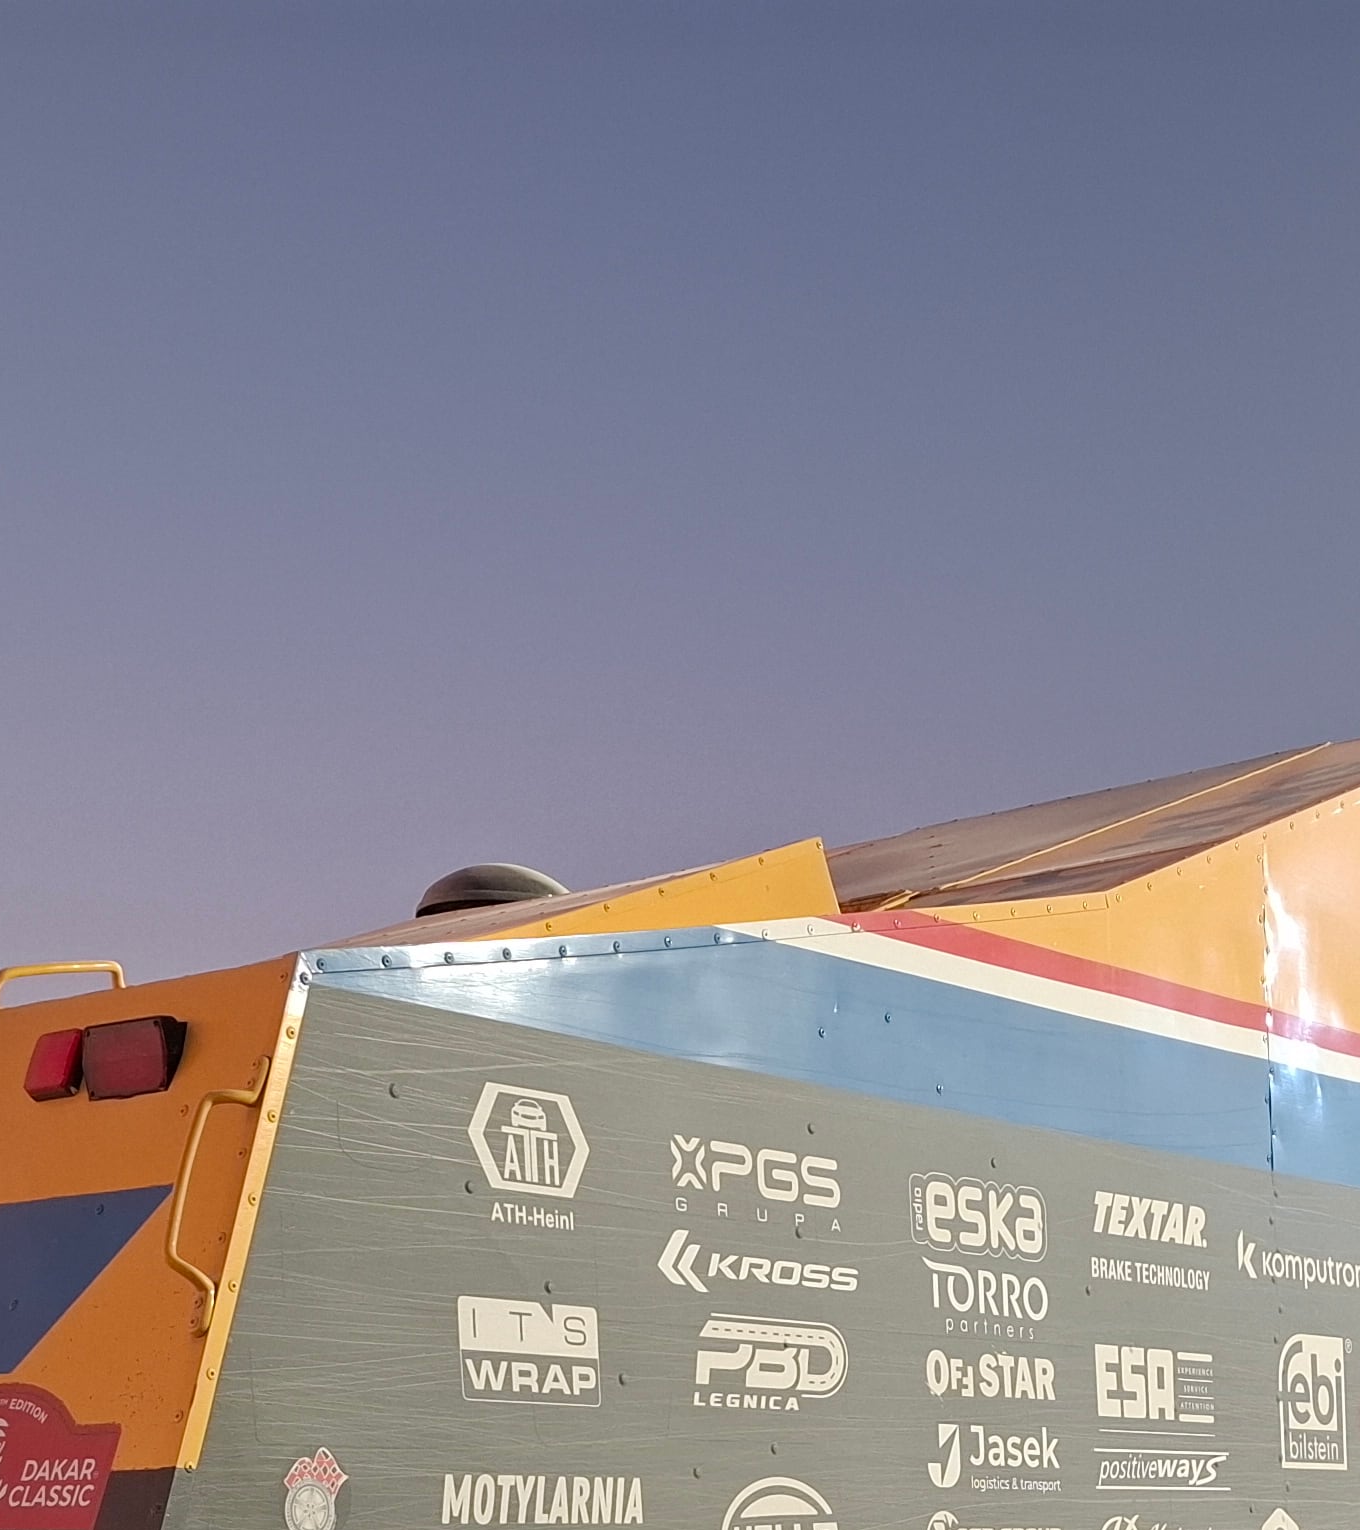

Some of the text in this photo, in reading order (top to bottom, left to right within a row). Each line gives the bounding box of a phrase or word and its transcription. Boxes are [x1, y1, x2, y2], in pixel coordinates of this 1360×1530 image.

[501, 1125, 560, 1186] ATH
[491, 1202, 575, 1231] ATH-Heinl
[675, 1197, 841, 1232] GRUPA
[913, 1187, 924, 1231] radio
[926, 1181, 1043, 1254] eska
[707, 1252, 859, 1291] KROSS
[921, 1255, 1049, 1321] TORRO
[1091, 1256, 1211, 1292] BRAKE TECHNOLOGY
[945, 1317, 1036, 1340] partners
[464, 1357, 598, 1396] WRAP
[1094, 1343, 1176, 1422] ESA
[1277, 1339, 1342, 1426] febi
[8, 1398, 49, 1425] EDITION
[693, 1391, 800, 1411] LEGNICA
[969, 1424, 1061, 1469] Jasek
[1289, 1431, 1339, 1461] bilstein
[20, 1457, 96, 1482] DAKAR
[971, 1476, 1062, 1494] logistics & transport
[1098, 1453, 1228, 1487] positiveways
[8, 1484, 95, 1507] CLASSIC
[441, 1473, 644, 1526] MOTYLARNIA
